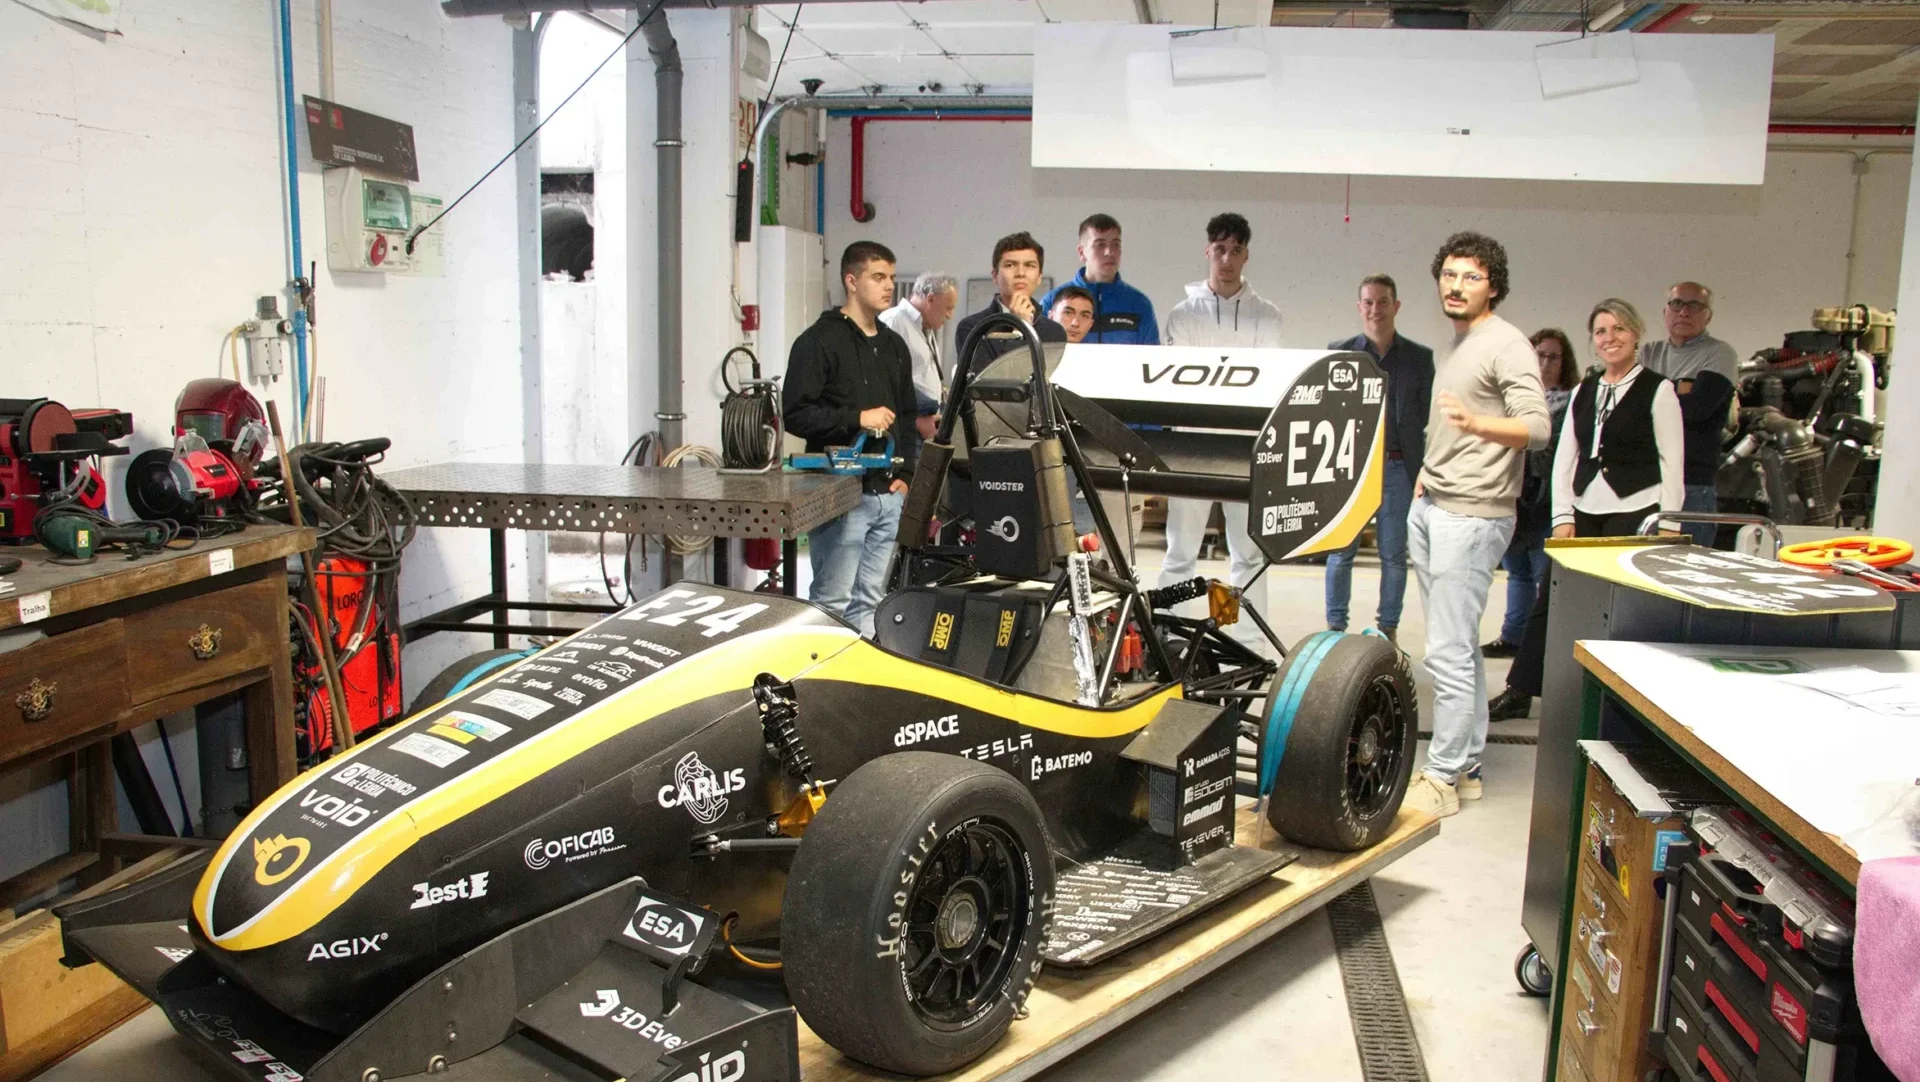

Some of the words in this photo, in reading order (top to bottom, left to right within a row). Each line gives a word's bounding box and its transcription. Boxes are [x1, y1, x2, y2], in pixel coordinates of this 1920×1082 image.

[1143, 356, 1259, 387] VOID
[1333, 368, 1354, 383] ESA
[1287, 419, 1355, 486] E24
[979, 480, 1025, 492] VOIDSTER
[1277, 499, 1316, 519] POLITÉCNICO
[1283, 517, 1303, 532] LEIRIA
[22, 604, 46, 616] Tralha
[336, 589, 366, 612] LORC
[618, 589, 770, 638] E24
[933, 612, 953, 650] OMP
[999, 609, 1014, 647] OMP
[571, 673, 608, 690] erofio
[368, 691, 393, 709] LOCH
[894, 714, 960, 747] dSPACE
[960, 733, 1034, 761] TESLA
[1045, 750, 1093, 773] BATEMO
[1196, 752, 1218, 769] RAMADA
[354, 779, 387, 798] LEIRIA
[360, 767, 417, 796] POLITÉCNICO
[657, 767, 747, 809] CARLIS
[299, 788, 371, 828] VOID
[565, 851, 590, 863] Powered
[638, 909, 687, 943] ESA
[1057, 920, 1117, 932] foxglove
[899, 960, 914, 1002] RACING
[610, 1006, 689, 1050] 3DEve
